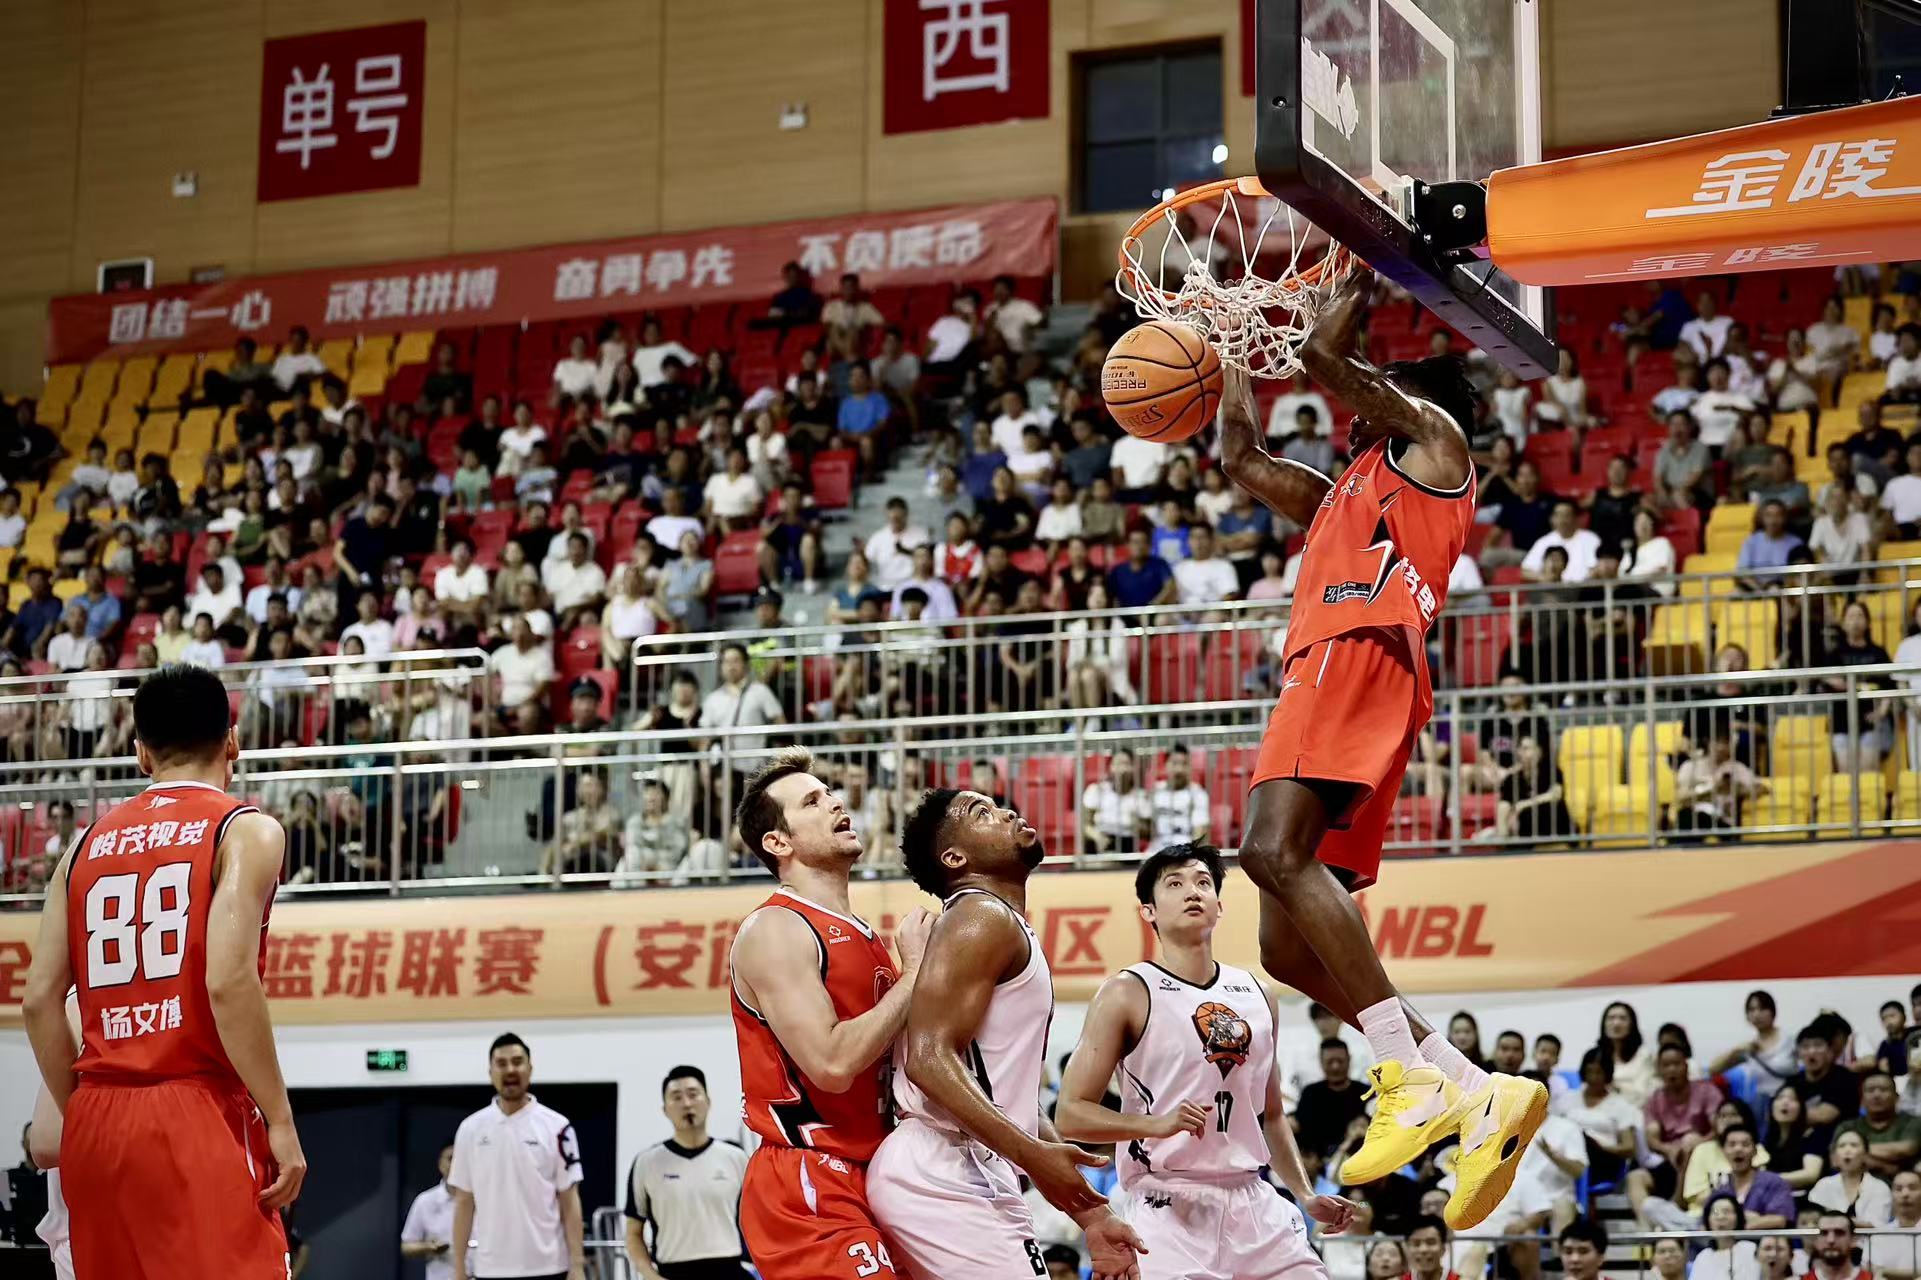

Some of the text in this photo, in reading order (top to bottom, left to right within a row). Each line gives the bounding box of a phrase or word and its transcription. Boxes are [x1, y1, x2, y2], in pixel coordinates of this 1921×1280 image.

[917, 0, 1010, 102] 西
[275, 54, 408, 170] 单号
[1645, 138, 1921, 219] 金陵
[109, 220, 985, 344] 团结一心 顽强拼搏 奋勇争先 不负使命
[1584, 242, 1872, 279] 金陵
[88, 818, 209, 861] 峻茂视觉
[84, 860, 193, 989] 88
[1374, 903, 1496, 959] NBL
[100, 995, 183, 1041] 杨文博
[1214, 1090, 1235, 1134] 17
[847, 1239, 896, 1279] 34
